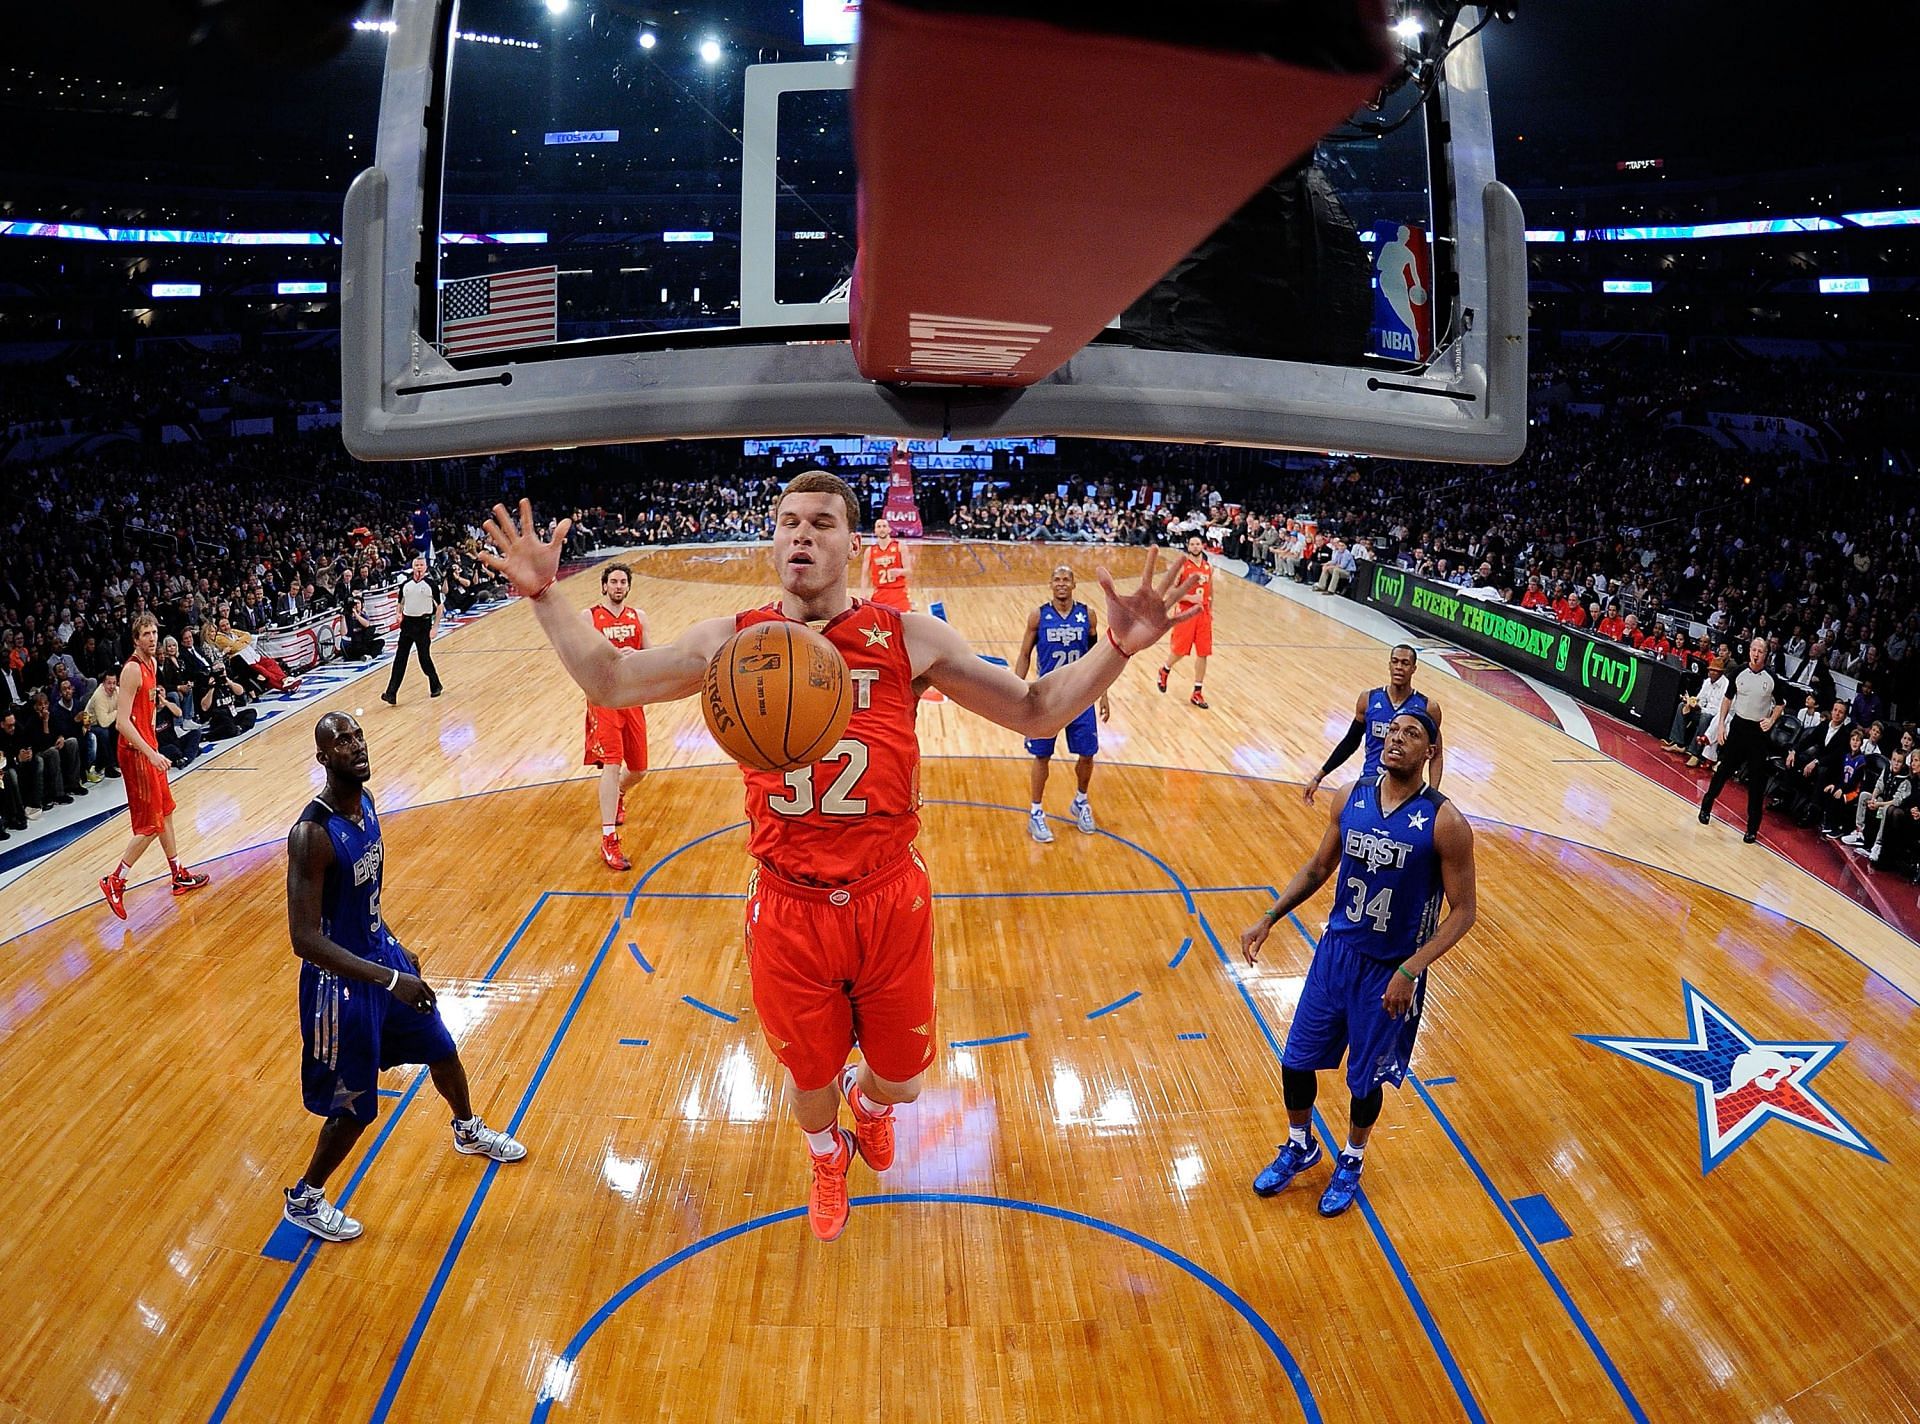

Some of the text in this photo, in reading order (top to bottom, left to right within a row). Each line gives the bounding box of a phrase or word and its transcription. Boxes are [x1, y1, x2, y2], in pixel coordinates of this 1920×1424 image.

[794, 231, 826, 240] STAPLES
[909, 313, 1053, 370] NBA TV
[1382, 329, 1412, 352] NBA
[602, 624, 636, 640] WEST
[1046, 626, 1084, 642] EAST
[1412, 586, 1460, 622] EVERY
[1462, 603, 1554, 659] THURSDAY
[1052, 649, 1081, 669] 20
[1371, 720, 1390, 739] EA
[767, 737, 869, 816] 32
[1344, 828, 1413, 869] EAST
[369, 886, 382, 933] 5
[1345, 876, 1393, 932] 34
